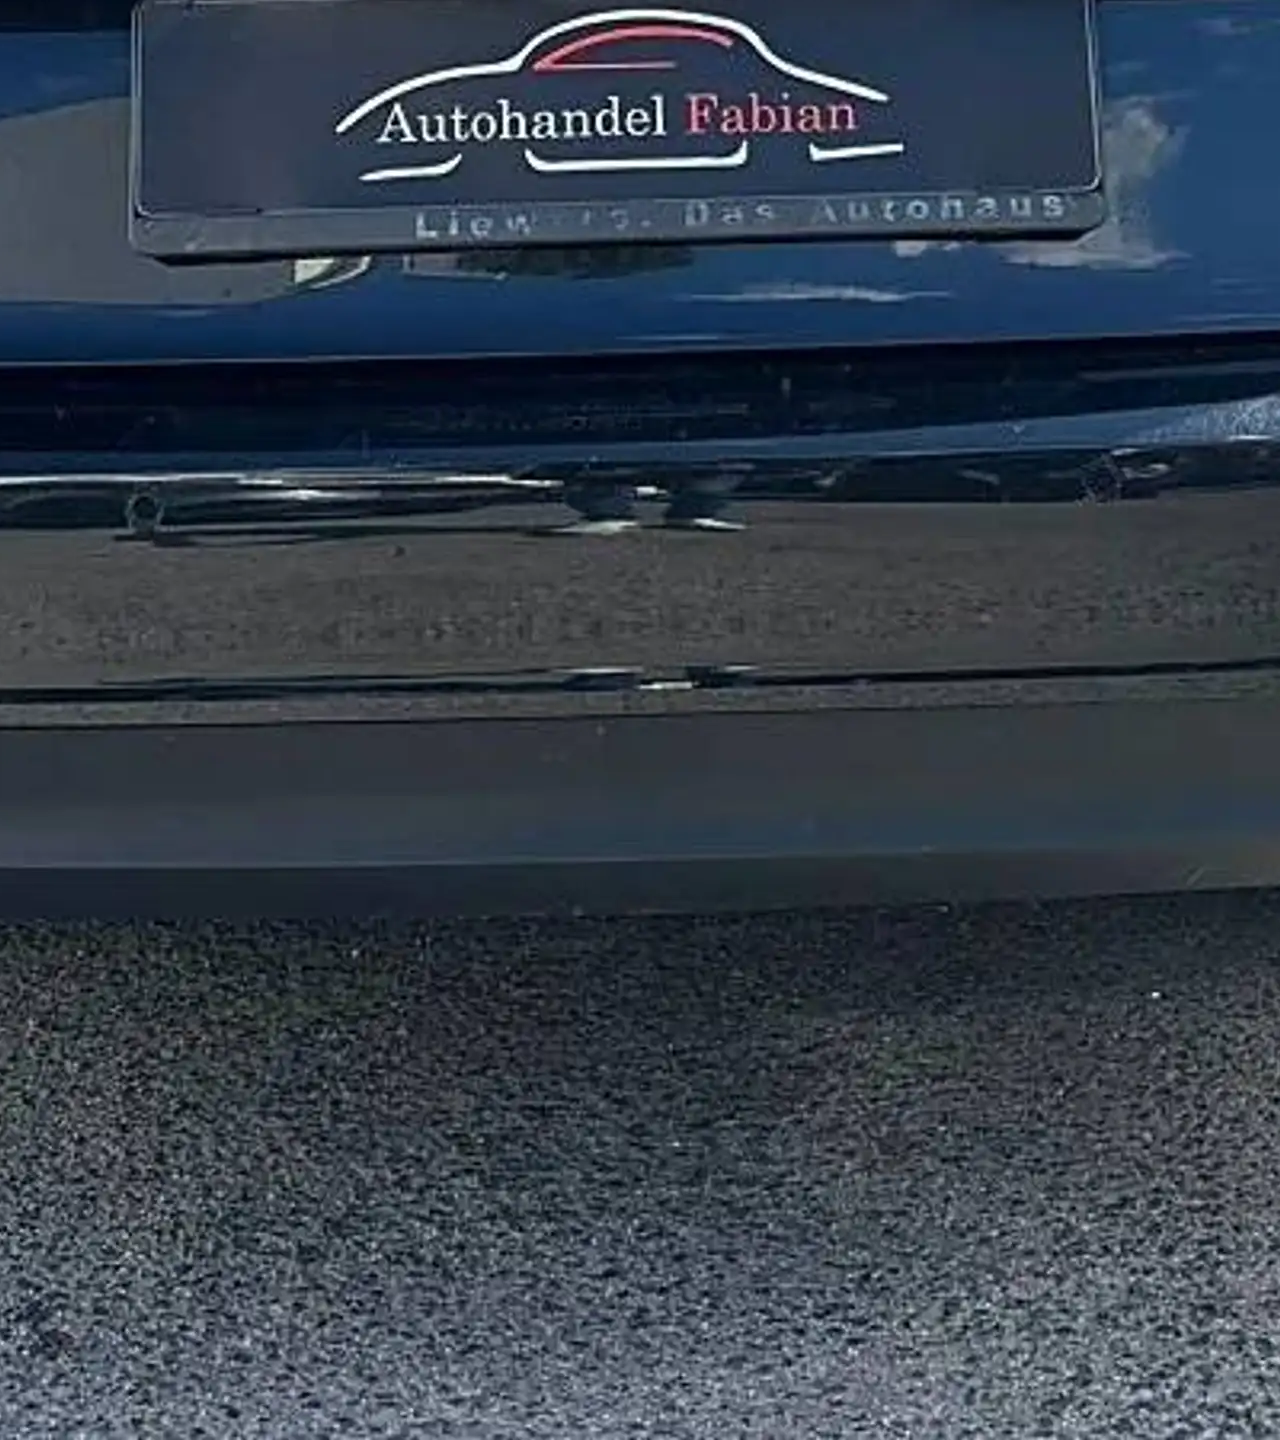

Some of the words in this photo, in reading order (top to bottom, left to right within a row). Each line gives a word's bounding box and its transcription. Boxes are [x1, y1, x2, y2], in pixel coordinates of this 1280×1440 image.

[375, 96, 668, 144] Autohandel
[684, 92, 859, 135] Fabian
[684, 200, 775, 227] Das
